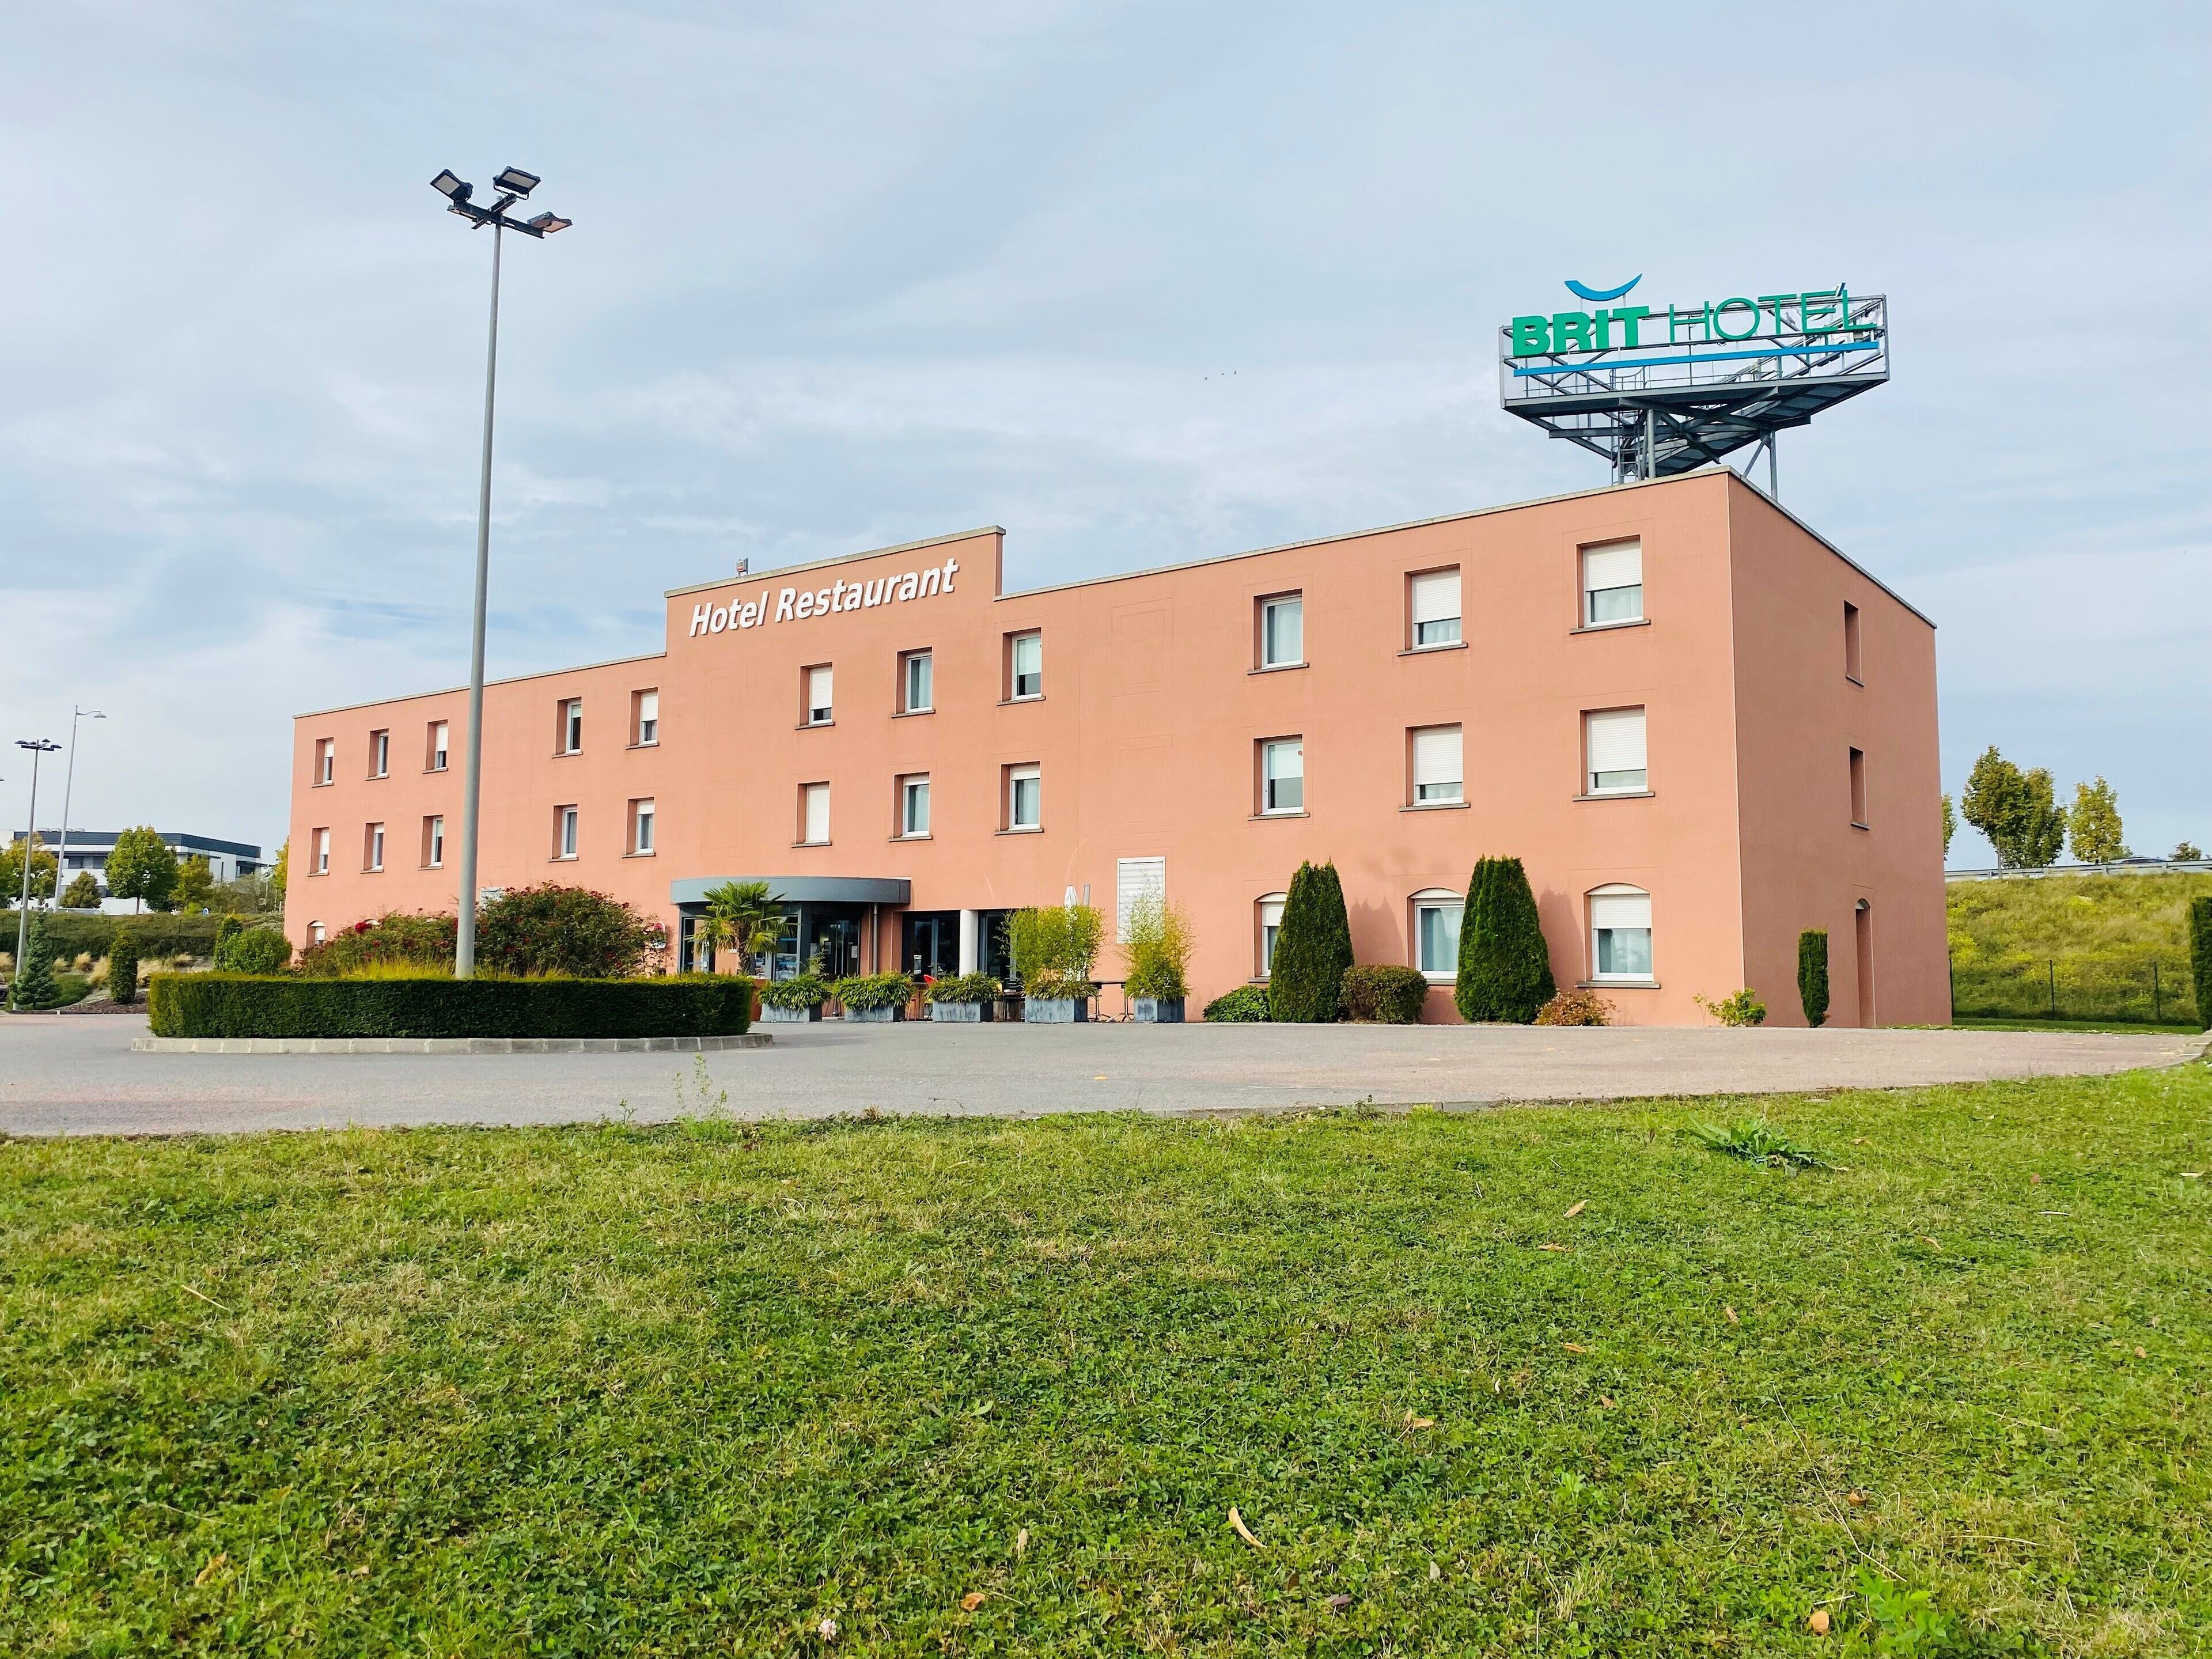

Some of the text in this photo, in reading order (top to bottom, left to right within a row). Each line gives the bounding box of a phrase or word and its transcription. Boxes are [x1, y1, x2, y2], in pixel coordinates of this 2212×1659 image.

[1512, 289, 1877, 358] BRIT HOTEL
[689, 556, 960, 637] Hotel Restaurant
